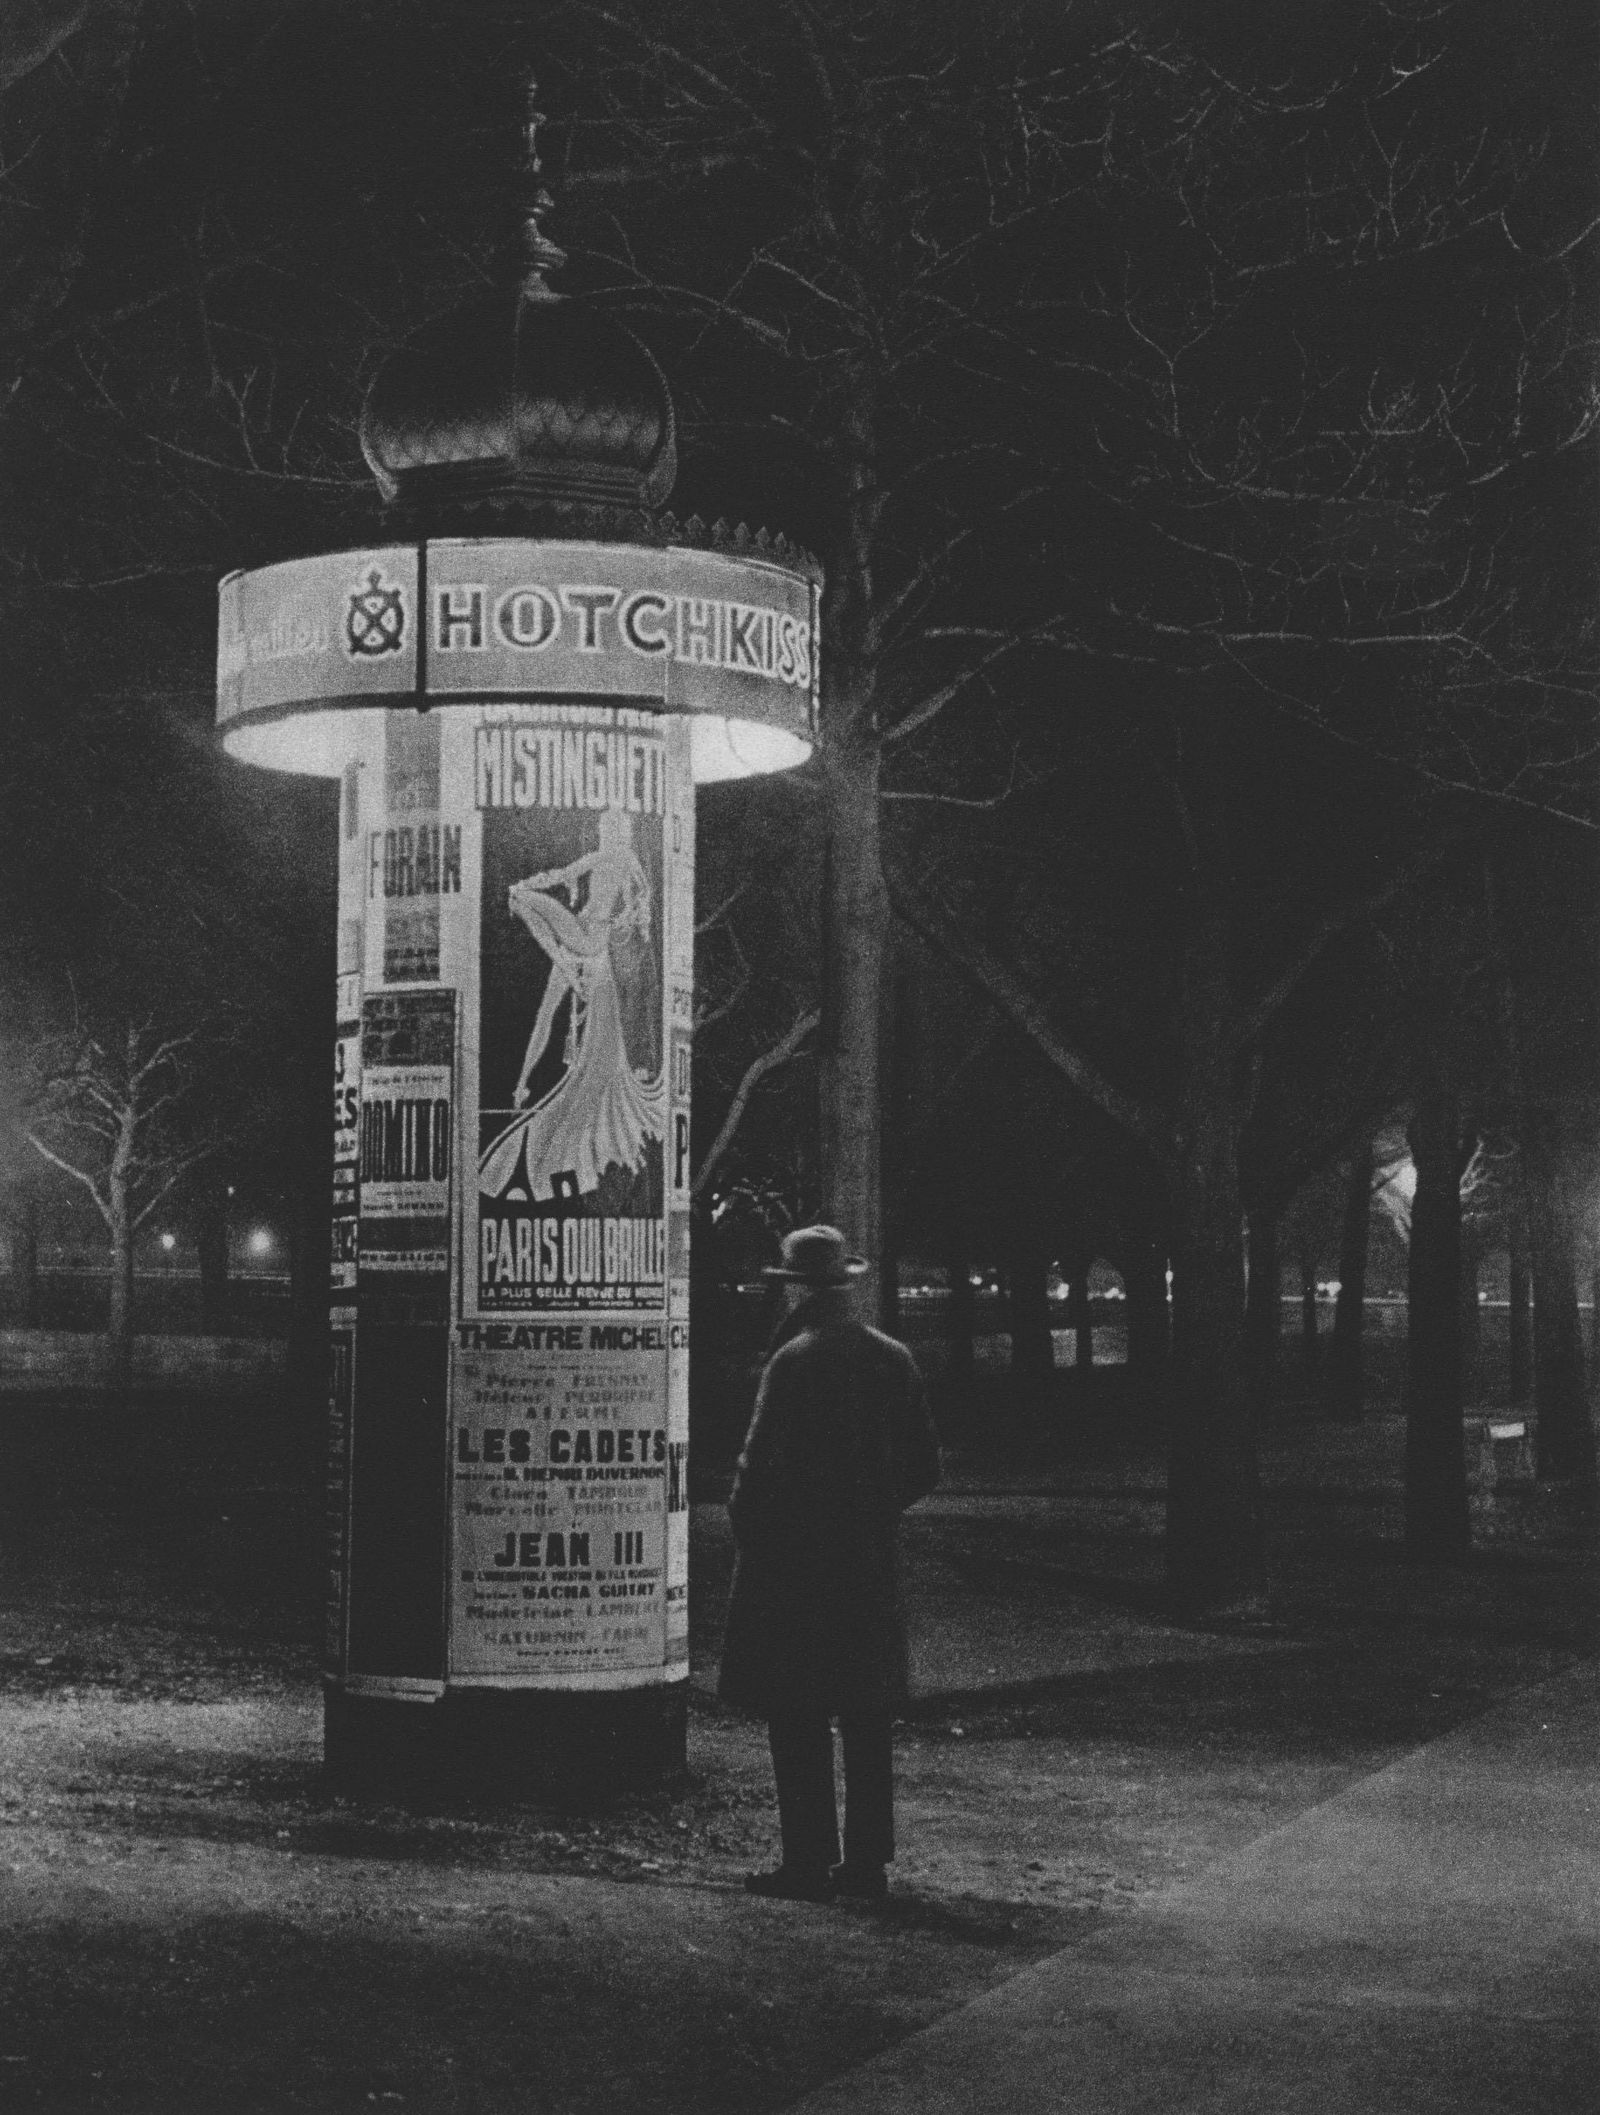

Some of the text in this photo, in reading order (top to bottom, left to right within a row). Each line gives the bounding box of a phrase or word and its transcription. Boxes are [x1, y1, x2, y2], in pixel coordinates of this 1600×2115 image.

[434, 584, 811, 687] HOTCHKISS
[481, 1217, 665, 1285] PARIS QUI BRILLE
[481, 1287, 496, 1298] LA
[500, 1287, 532, 1298] PLUS
[536, 1287, 572, 1298] BELLE
[576, 1286, 615, 1299] REVUE
[456, 1325, 667, 1350] THEATRE MICHEL
[458, 1428, 666, 1463] LES CADETS
[494, 1531, 643, 1567] JEAN III
[522, 1585, 591, 1600] SACHA
